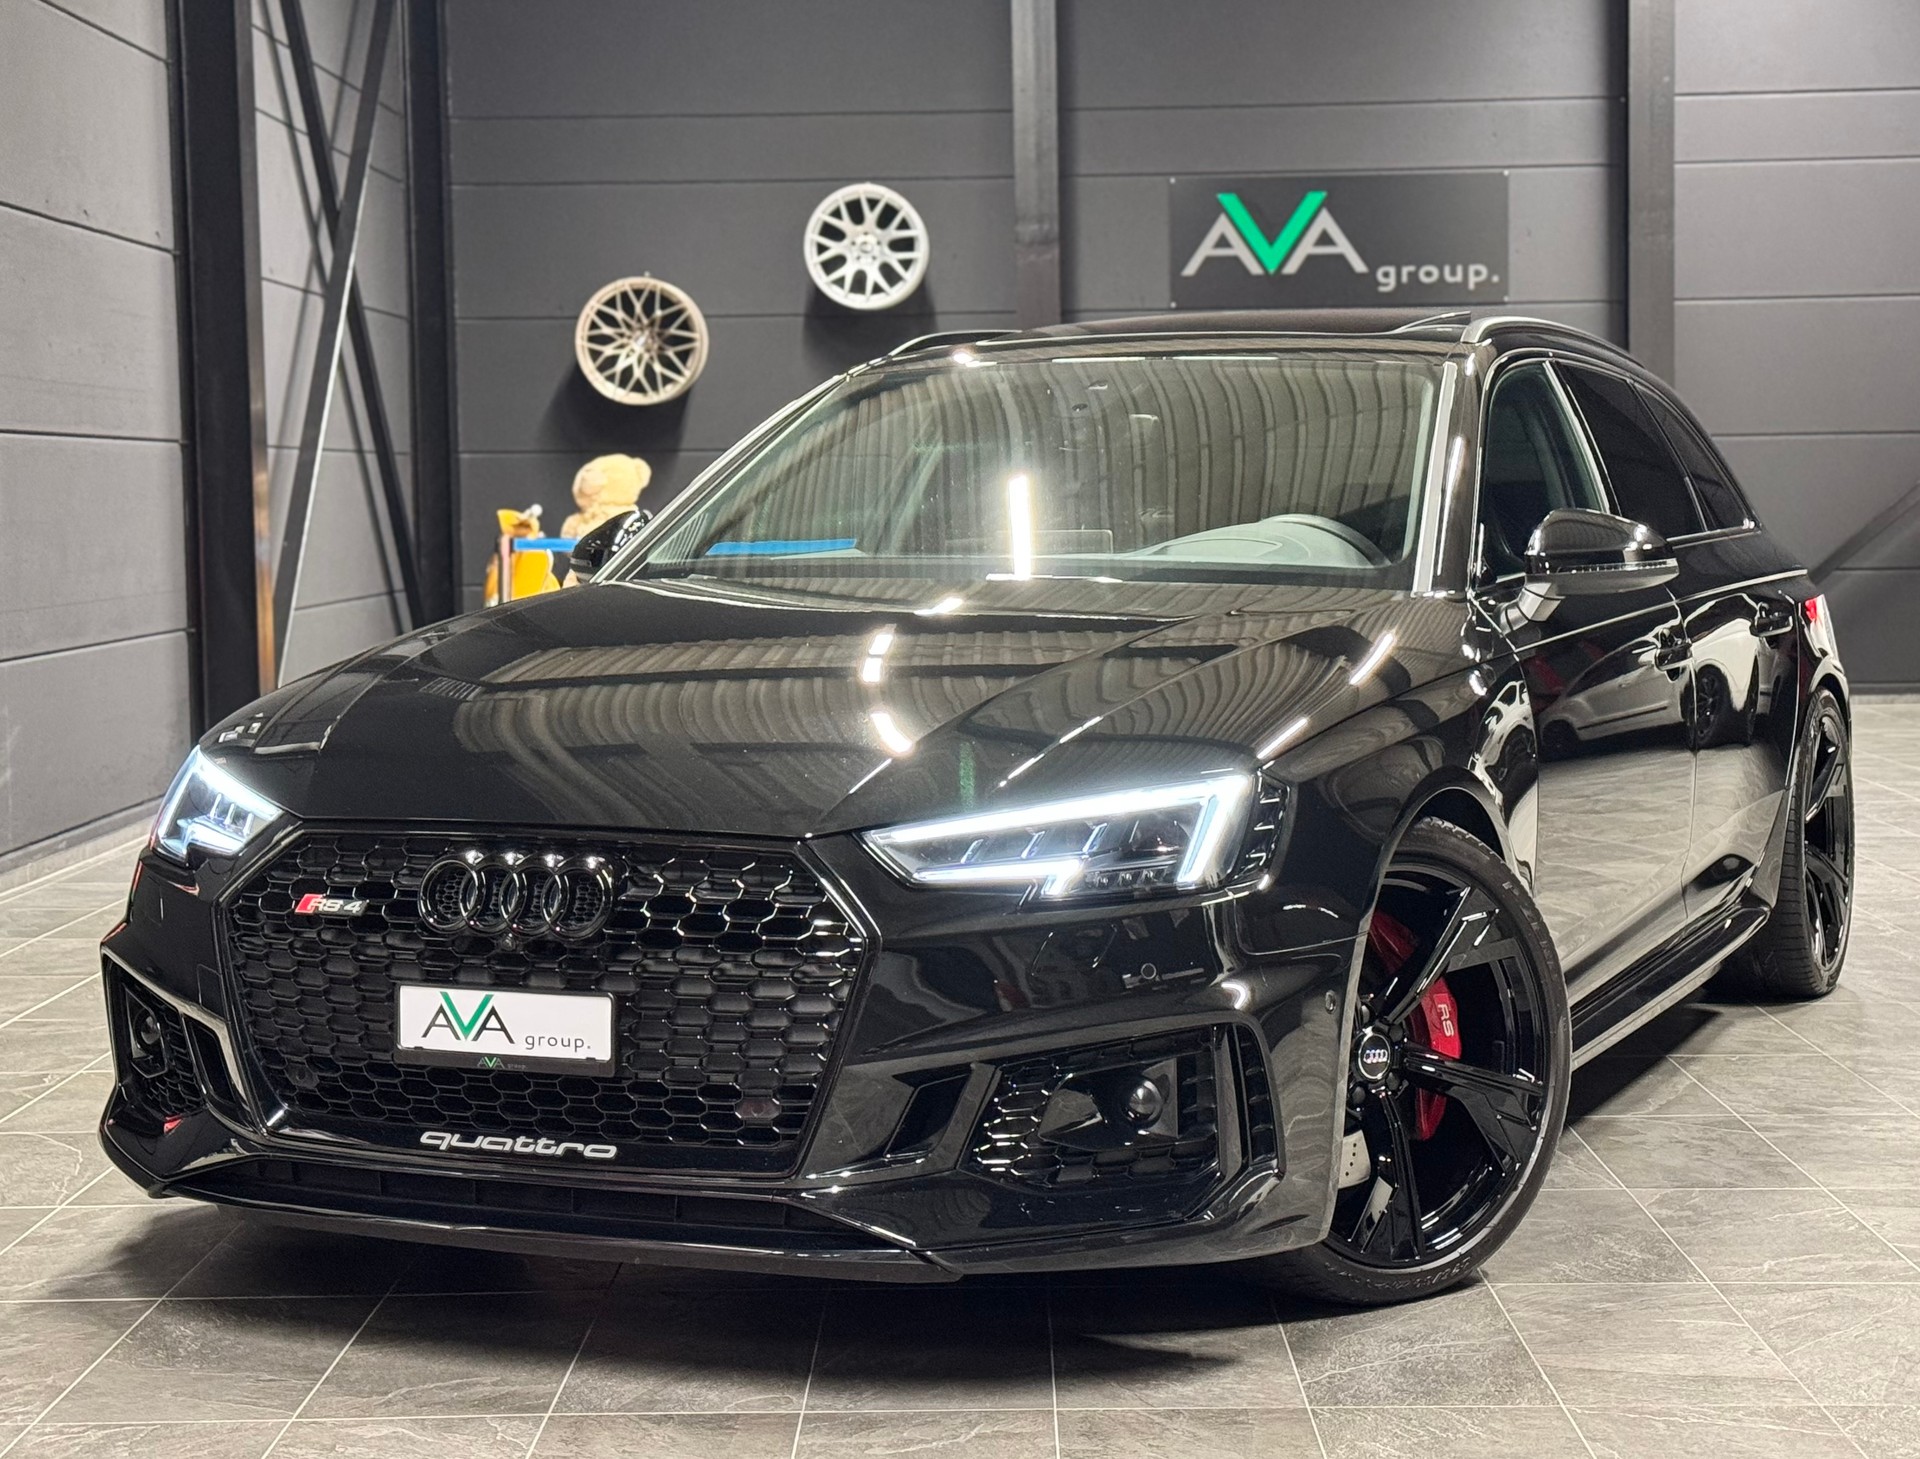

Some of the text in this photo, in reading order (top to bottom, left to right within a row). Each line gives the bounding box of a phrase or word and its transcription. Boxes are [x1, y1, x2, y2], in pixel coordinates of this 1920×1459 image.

[1180, 190, 1500, 292] AVA group.
[421, 991, 591, 1052] AVA group.
[1437, 1003, 1455, 1037] RS
[420, 1131, 617, 1159] quattro
